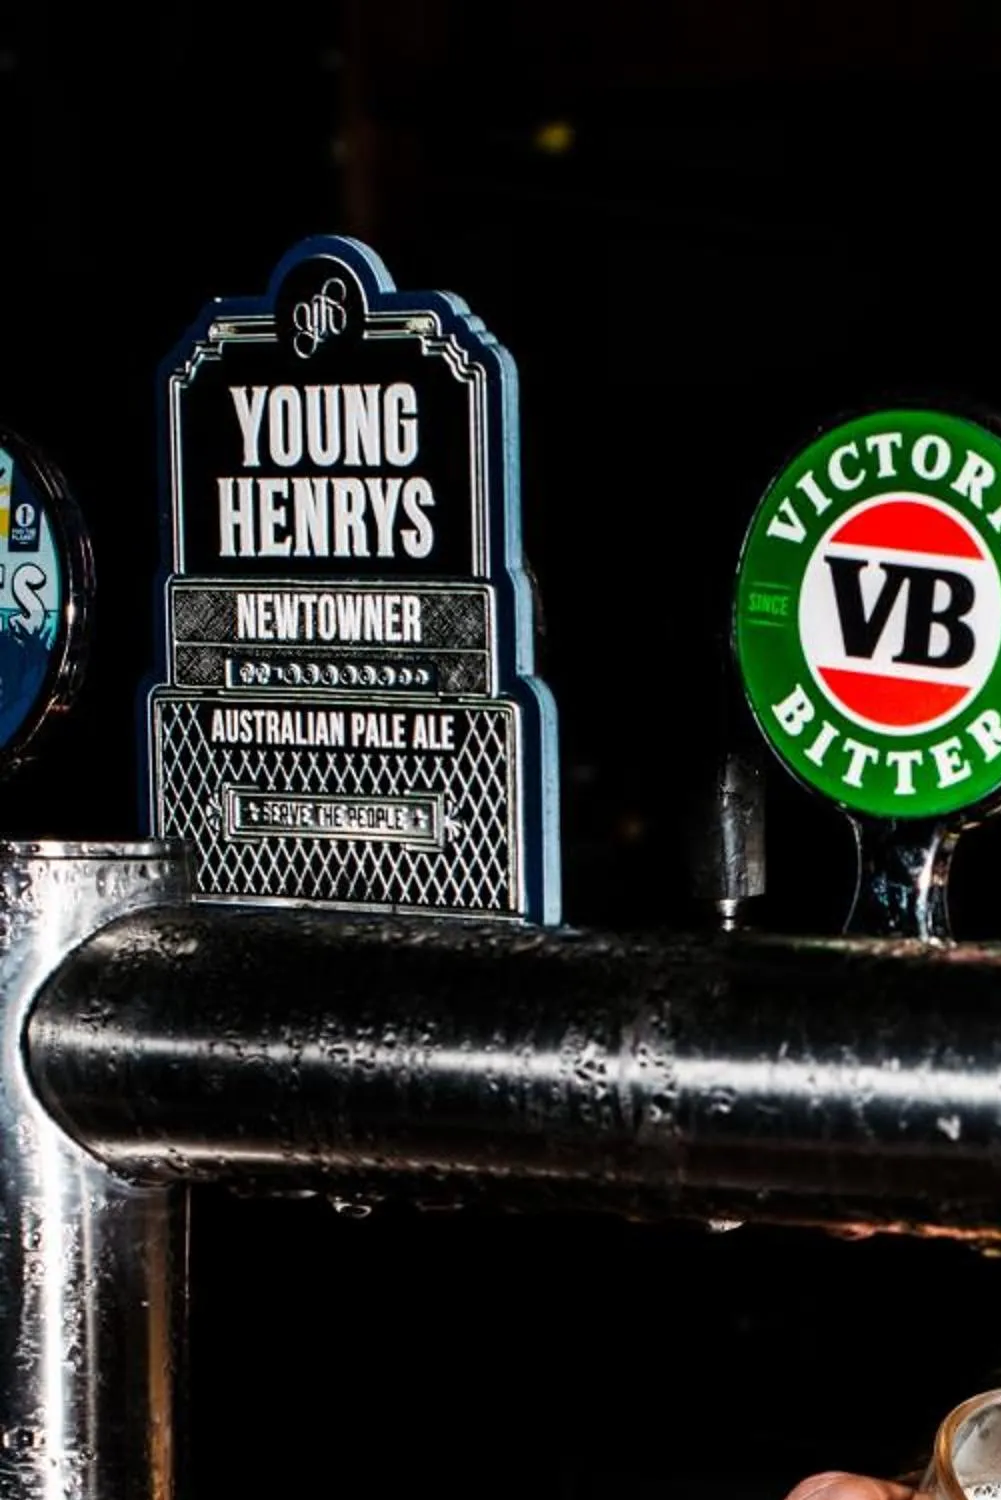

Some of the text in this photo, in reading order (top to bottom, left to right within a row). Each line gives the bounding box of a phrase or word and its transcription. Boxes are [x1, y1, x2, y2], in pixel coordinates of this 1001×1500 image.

[229, 382, 418, 467] YOUNG
[218, 477, 436, 560] HENRYS
[236, 593, 422, 643] NEWTOWNER
[748, 592, 789, 616] SINCE
[824, 554, 977, 669] VB
[211, 708, 455, 750] AUSTRALIAN PALE ALE
[263, 801, 403, 831] SERVE THE PEOPLE
